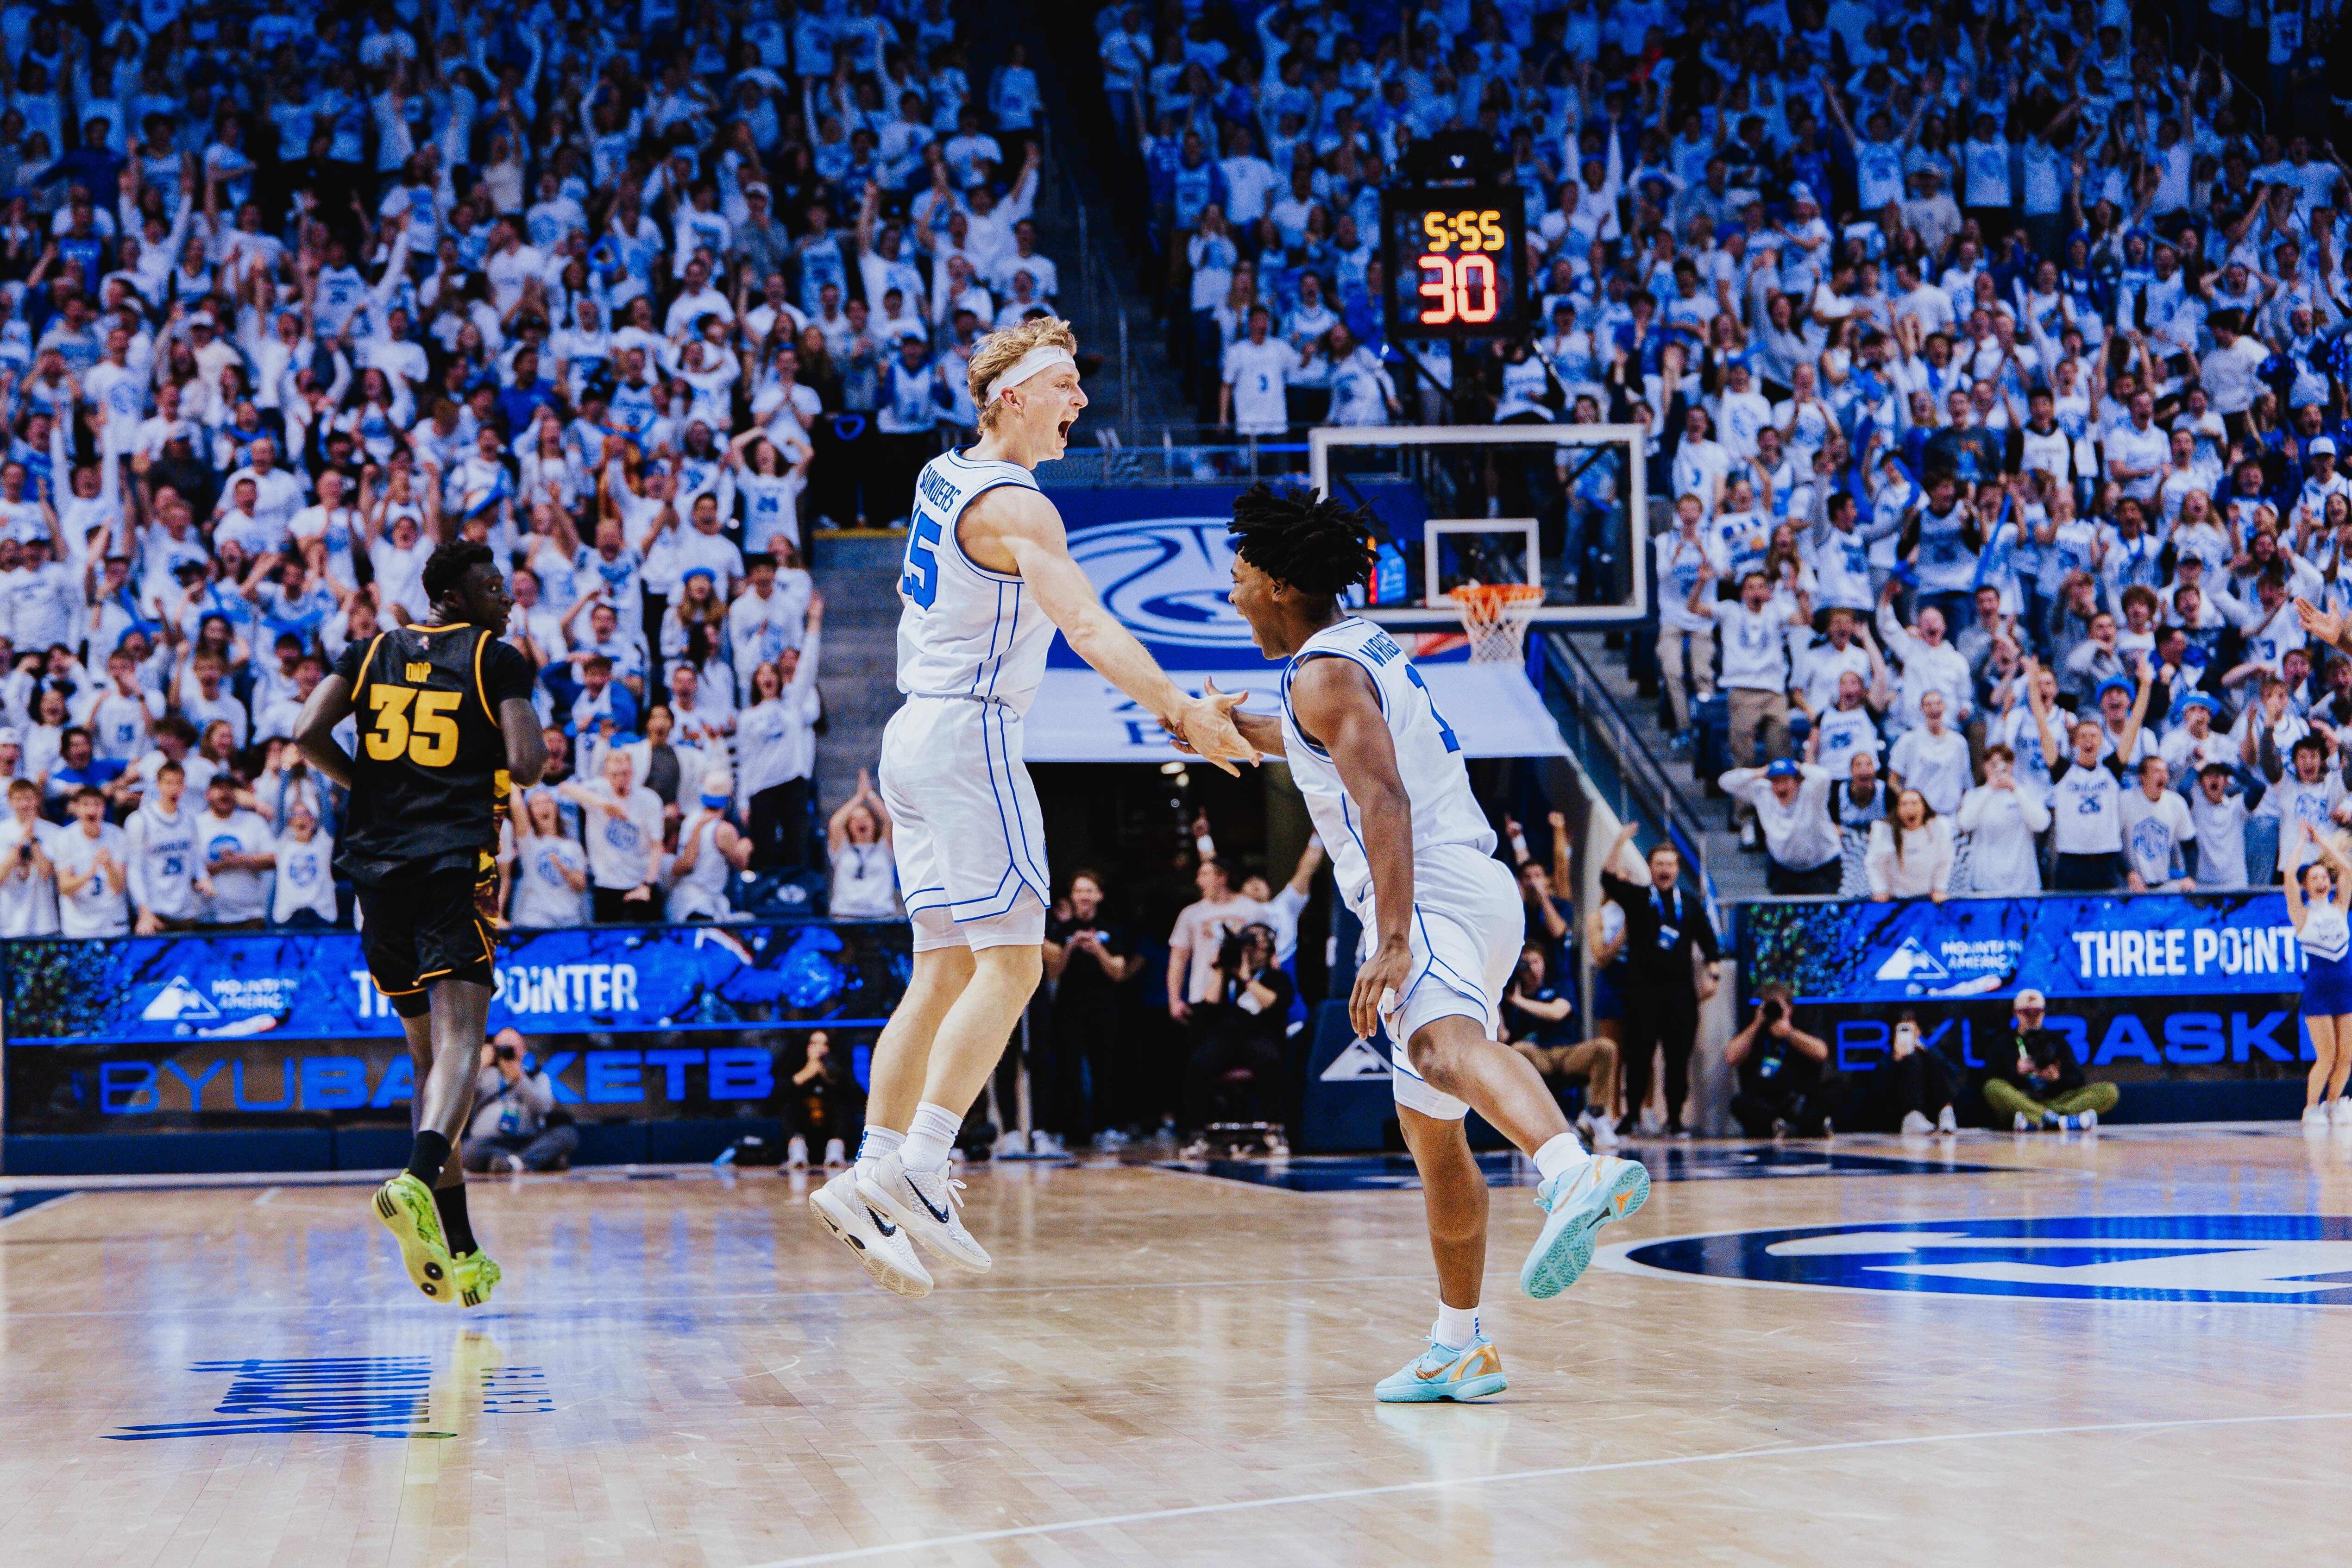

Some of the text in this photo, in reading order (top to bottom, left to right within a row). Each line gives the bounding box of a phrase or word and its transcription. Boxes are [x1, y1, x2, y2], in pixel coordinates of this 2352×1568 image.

[1424, 211, 1504, 252] 5:55
[1419, 254, 1497, 324] 30
[920, 464, 962, 512] SAUNDERS
[902, 504, 942, 611] 15
[406, 661, 432, 683] DIOP
[365, 683, 463, 768] 35
[2073, 928, 2187, 978] THREE
